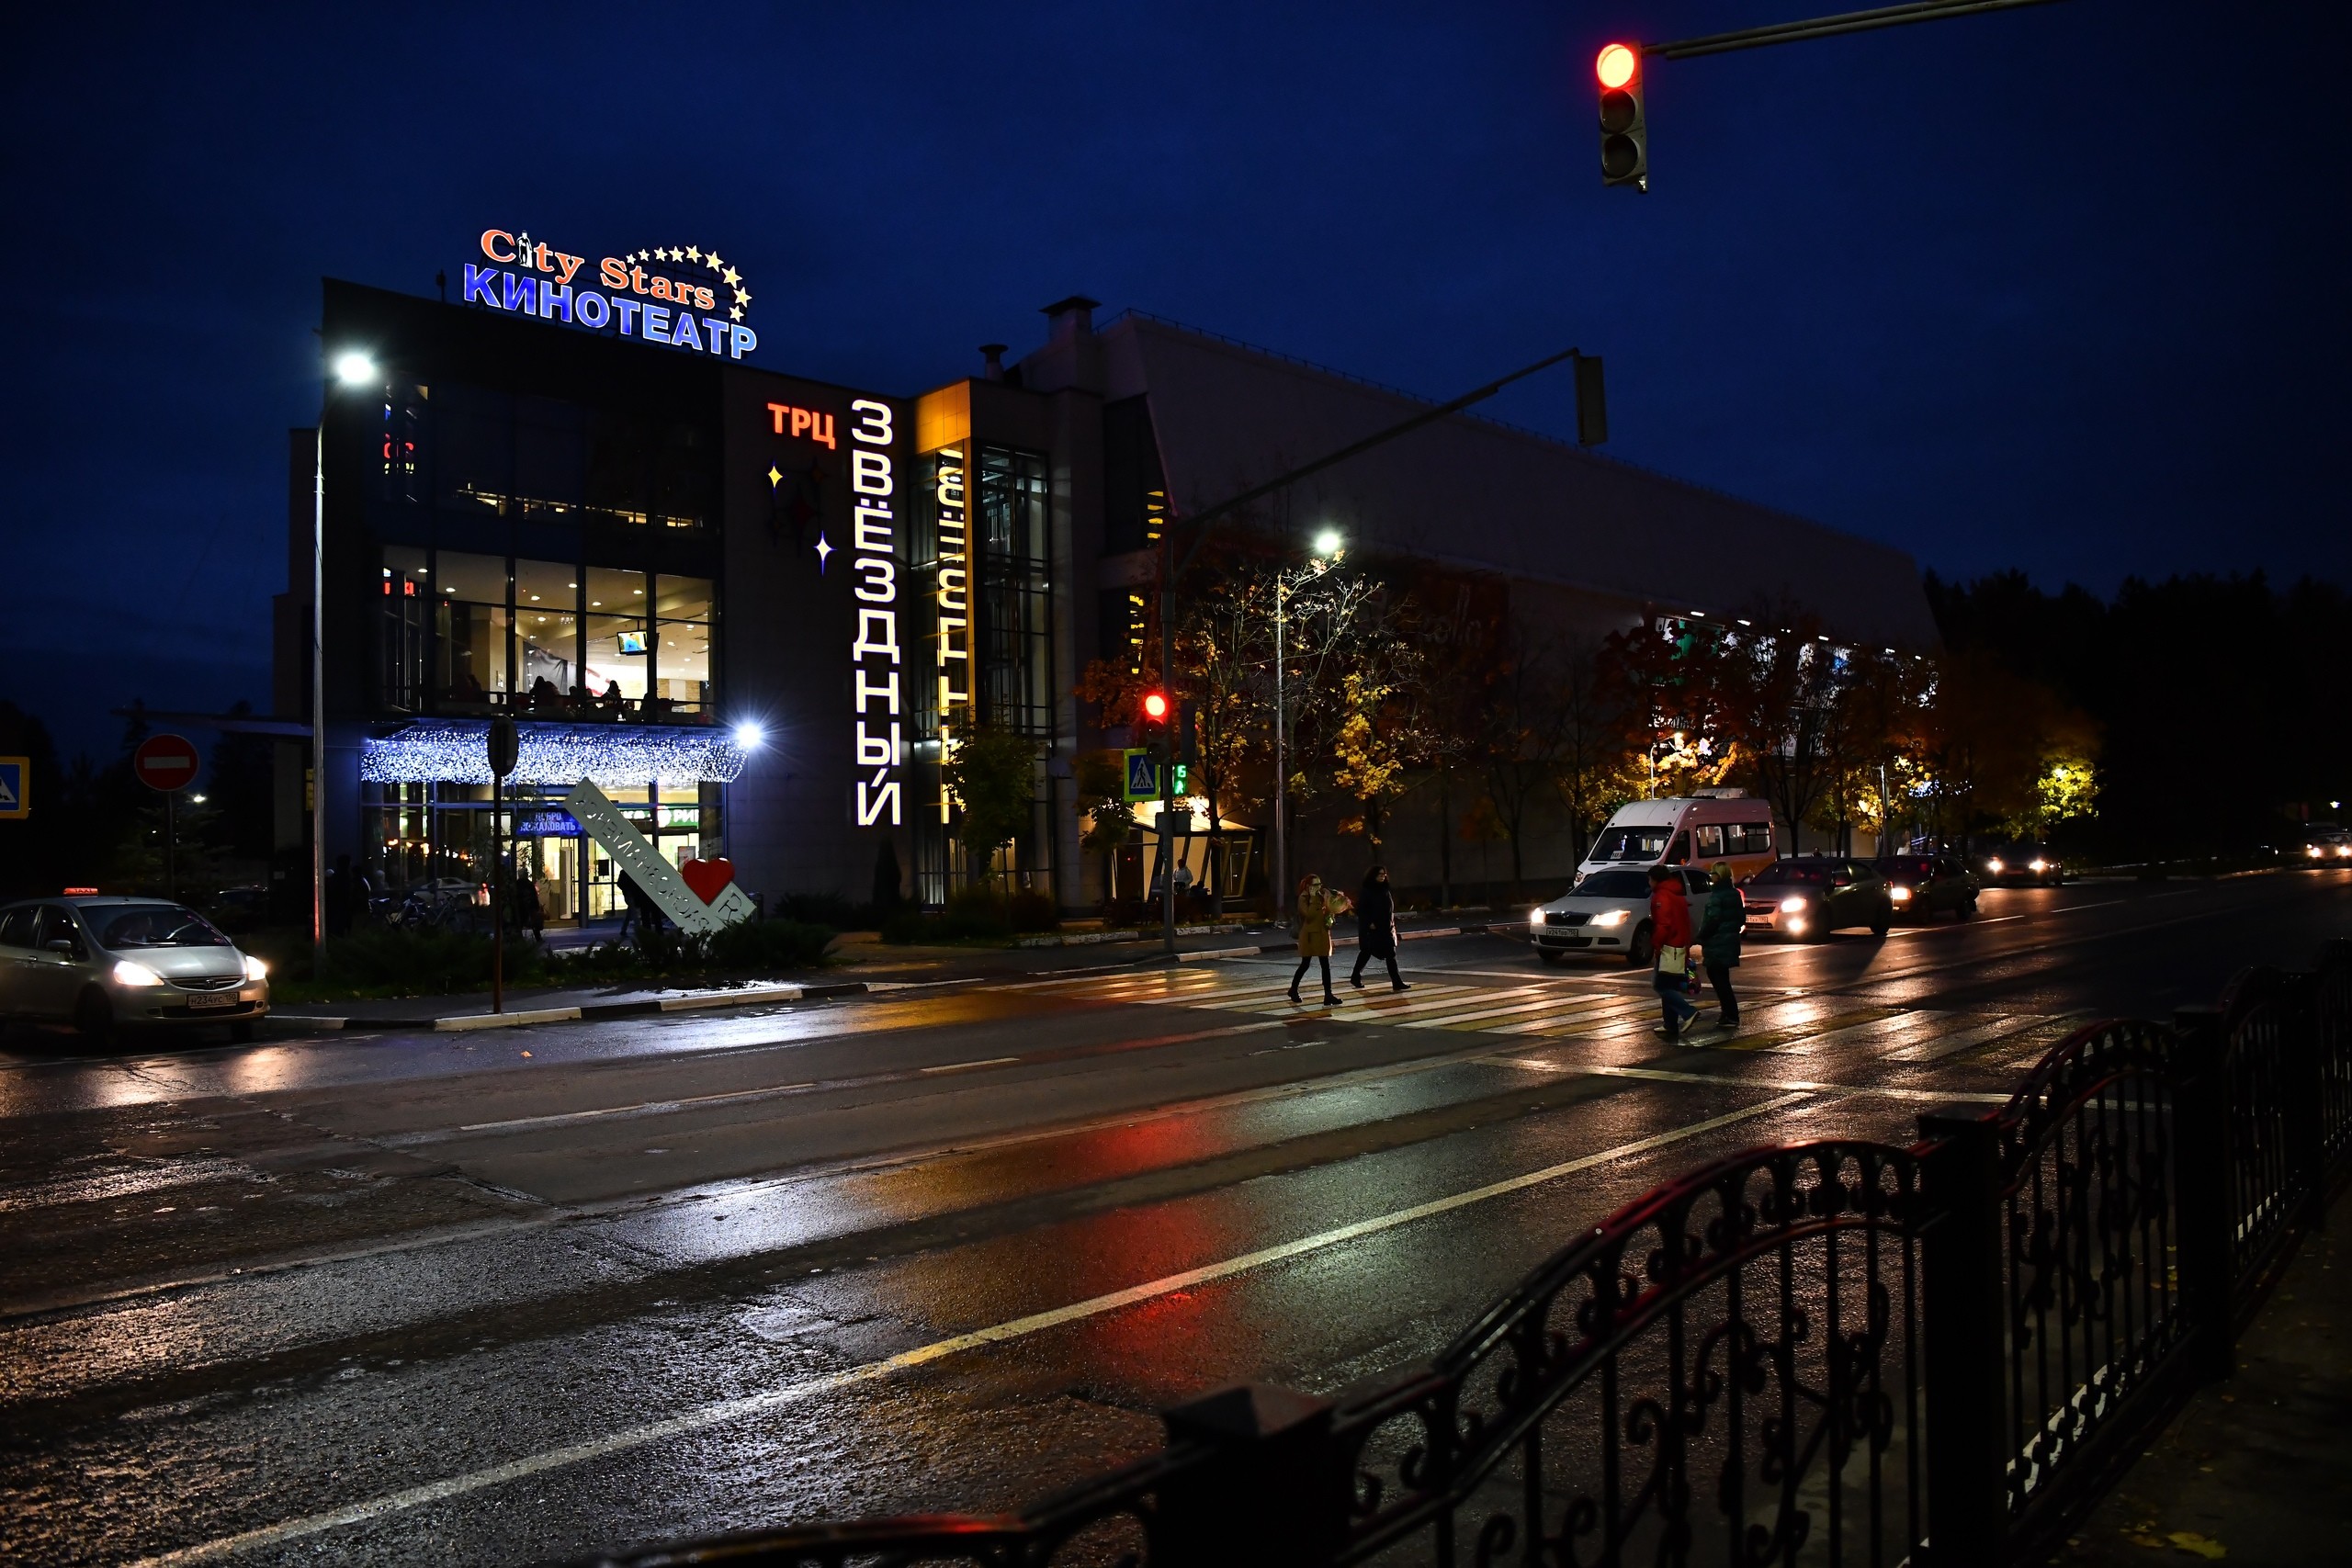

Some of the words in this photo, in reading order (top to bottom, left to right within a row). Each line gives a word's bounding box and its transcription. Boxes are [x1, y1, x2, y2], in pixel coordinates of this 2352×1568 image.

[464, 263, 757, 360] КИНОТЕАТР
[481, 230, 584, 284] City
[600, 257, 715, 310] Stars
[767, 402, 835, 450] ТРЦ
[851, 399, 900, 826] ЗВЁЗДНЫЙ
